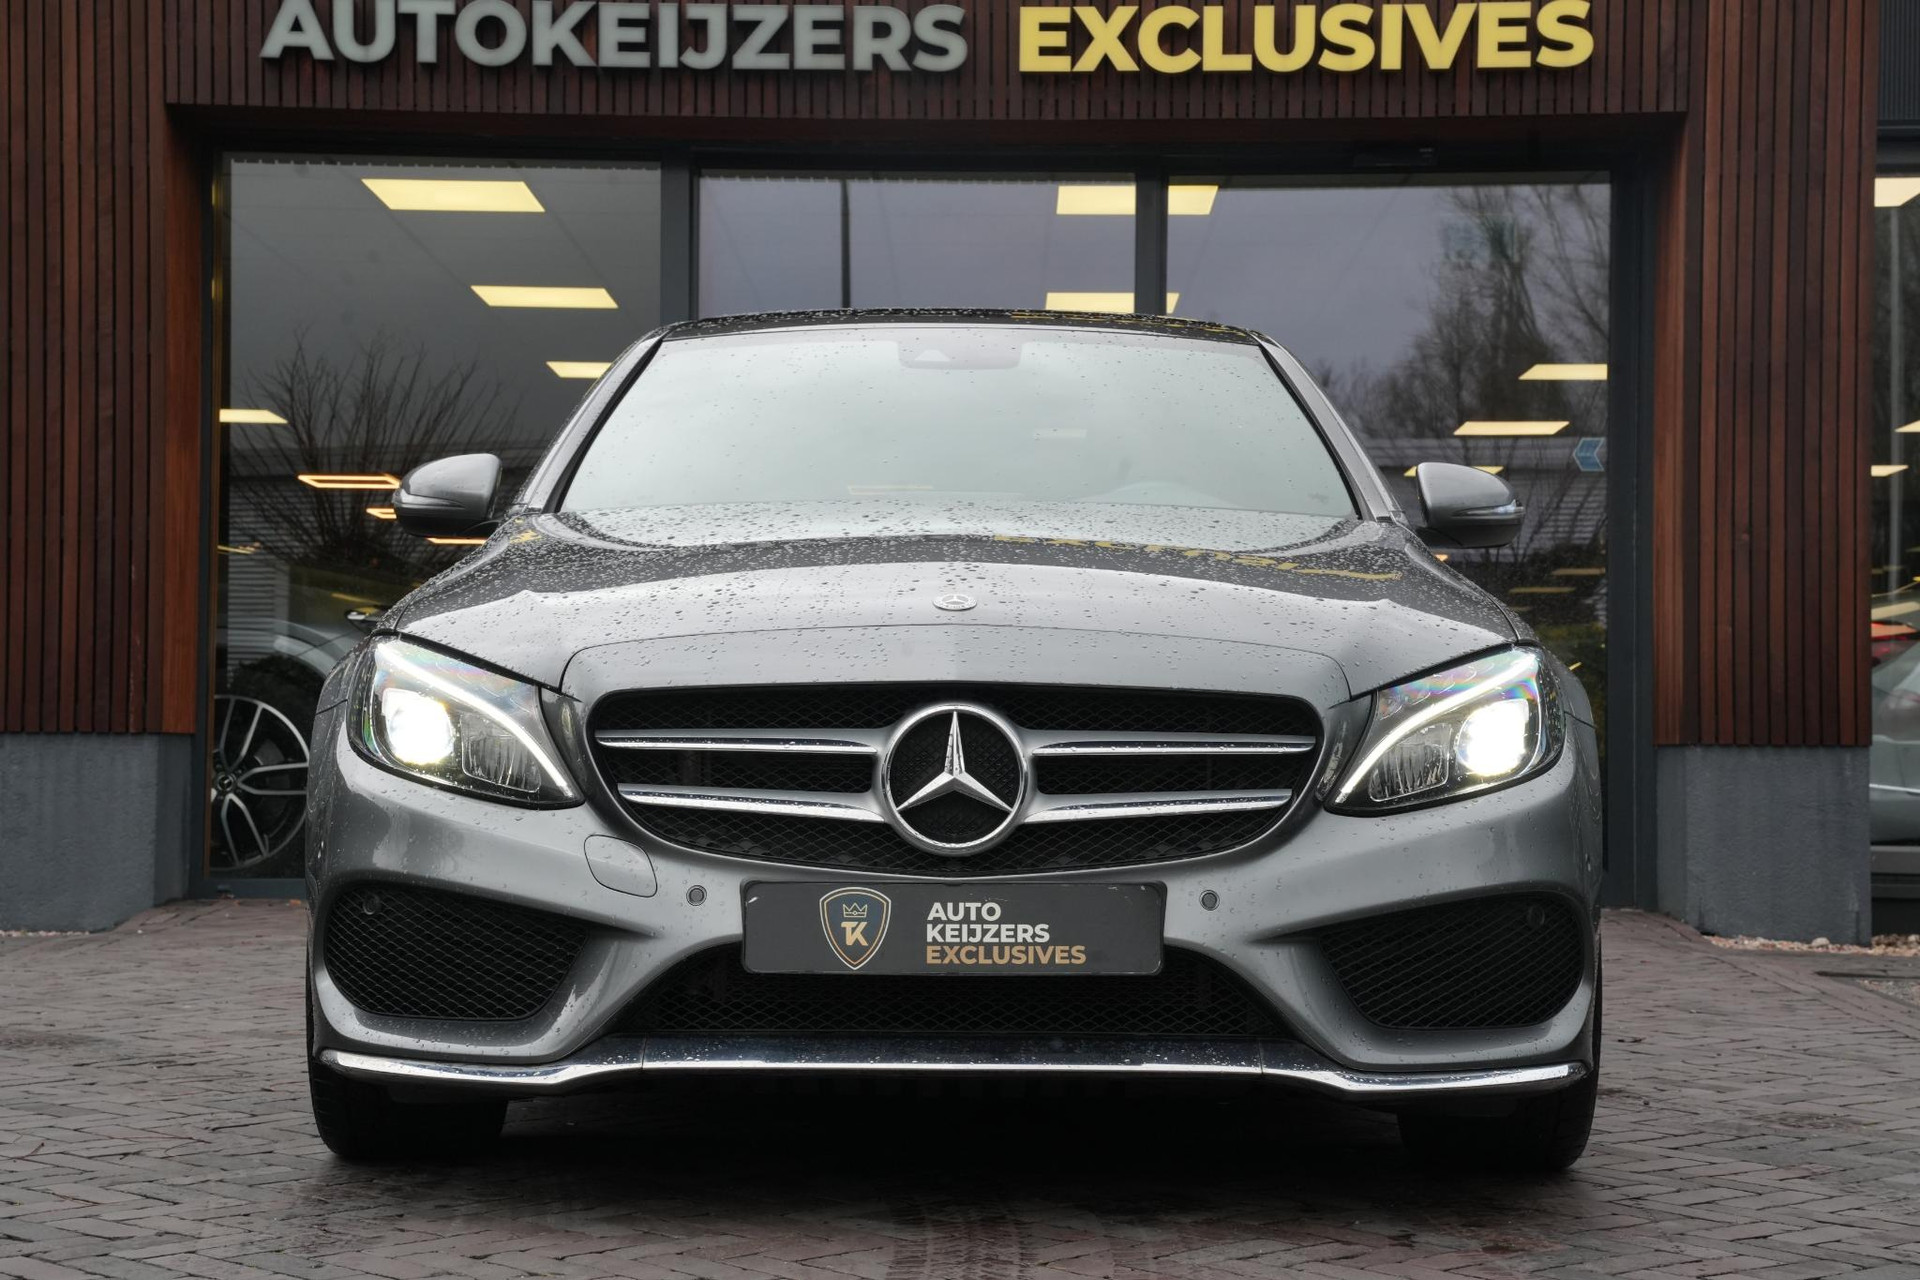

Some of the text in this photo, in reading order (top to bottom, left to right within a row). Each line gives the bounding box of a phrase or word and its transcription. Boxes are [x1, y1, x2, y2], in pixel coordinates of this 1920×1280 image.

[1019, 0, 1594, 73] EXCLUSIVES
[926, 902, 1002, 922] AUTO
[841, 921, 869, 946] TK
[926, 923, 1050, 943] KEIJZERS
[926, 945, 1087, 965] EXCLUSIVES
